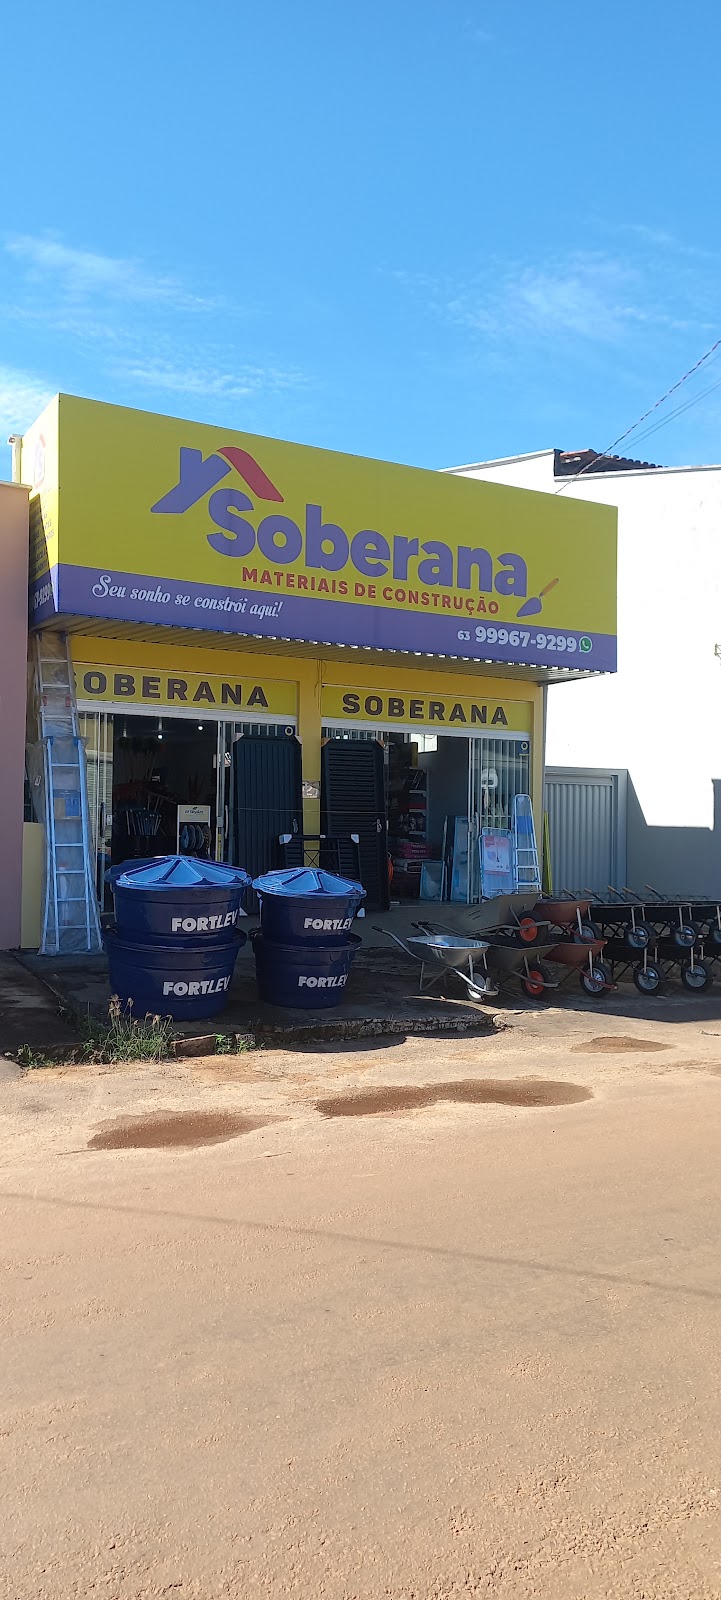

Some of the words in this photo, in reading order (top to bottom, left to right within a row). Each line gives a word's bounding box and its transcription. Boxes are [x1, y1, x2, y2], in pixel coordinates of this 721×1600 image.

[206, 488, 528, 598] Soberana
[92, 574, 127, 598] Seu
[130, 585, 171, 604] sonho
[174, 593, 191, 606] se
[194, 595, 249, 614] constrói
[249, 601, 284, 620] aqui!
[242, 566, 349, 595] MATERIAIS
[354, 582, 377, 599] DE
[382, 586, 499, 615] CONSTRUÇÃO
[457, 629, 471, 641] 63
[475, 625, 577, 653] 99967-9299
[73, 671, 269, 708] OBERANA
[342, 693, 509, 726] SOBERANA
[171, 909, 239, 932] FORTLEV
[163, 975, 231, 996] FORTLEV
